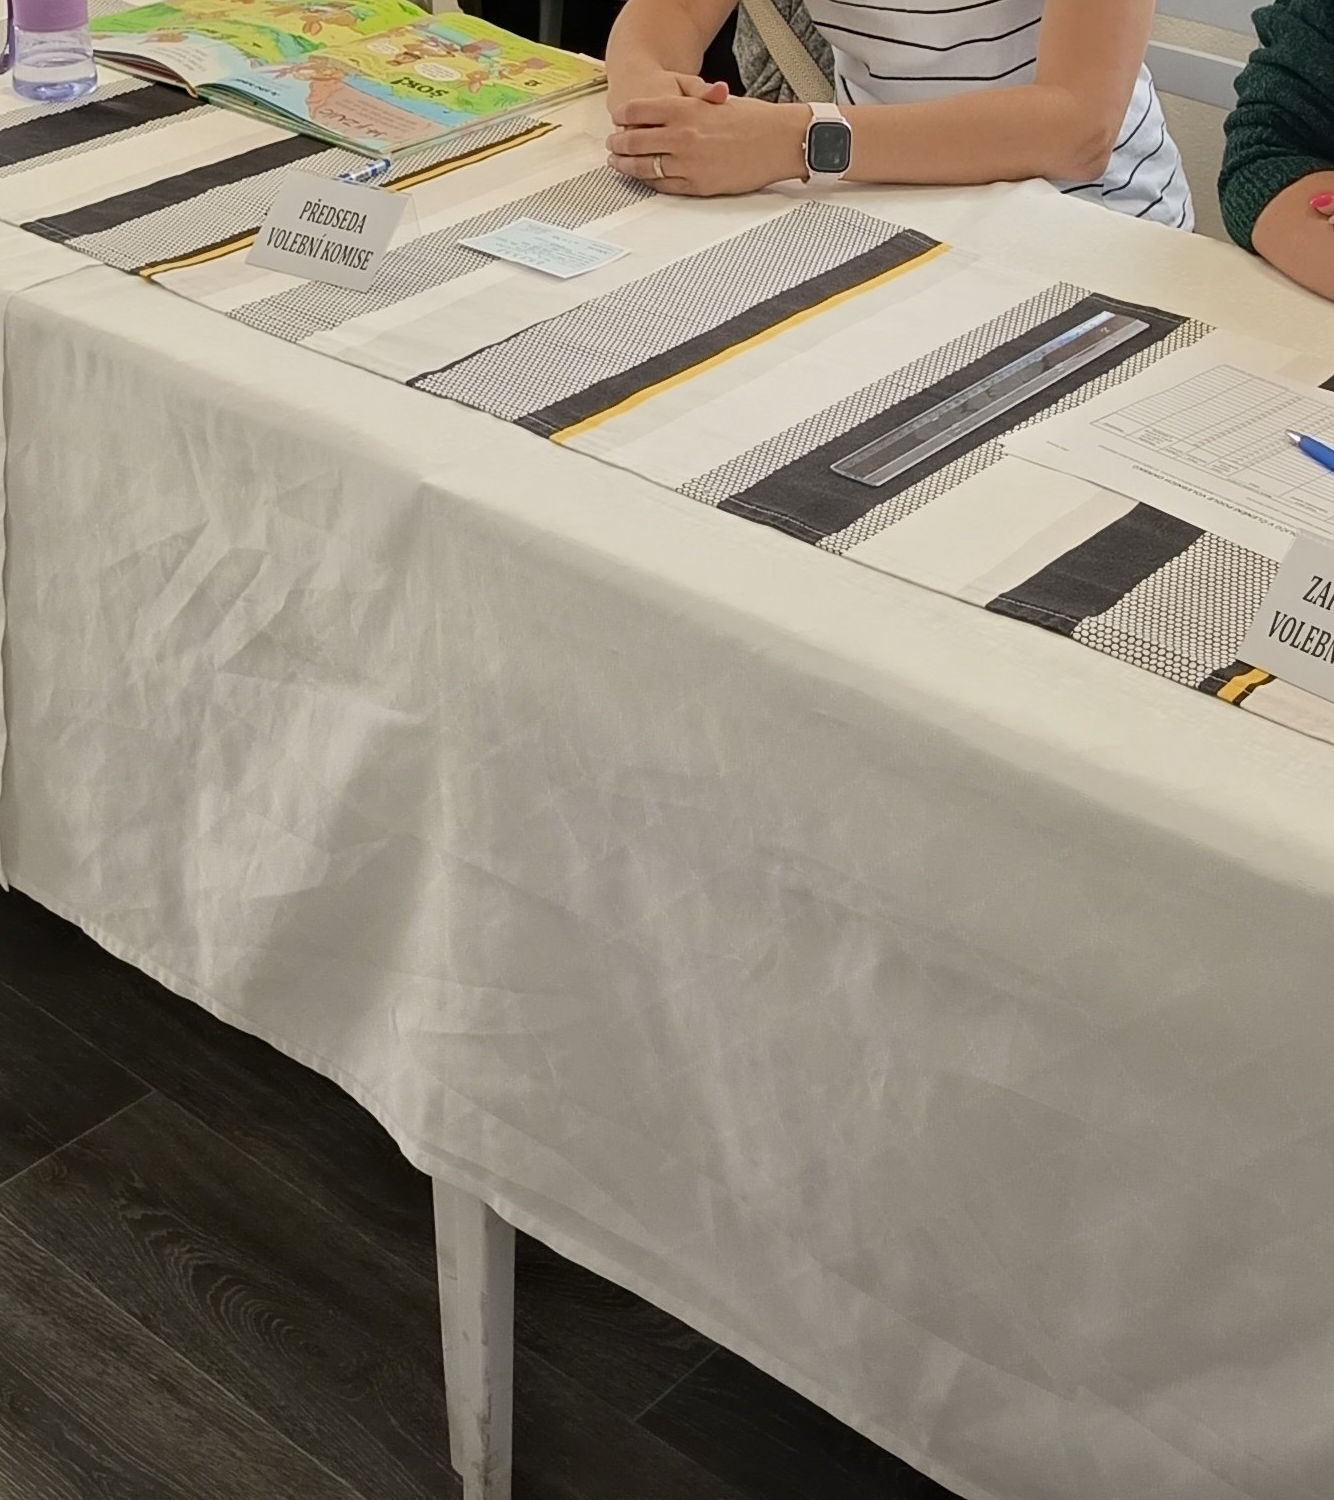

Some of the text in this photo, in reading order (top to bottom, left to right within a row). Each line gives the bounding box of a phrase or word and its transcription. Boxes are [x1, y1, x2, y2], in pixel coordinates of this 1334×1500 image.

[299, 198, 367, 234] PŘEDSEDA
[267, 227, 374, 271] VOLEBNÍ KOMISE
